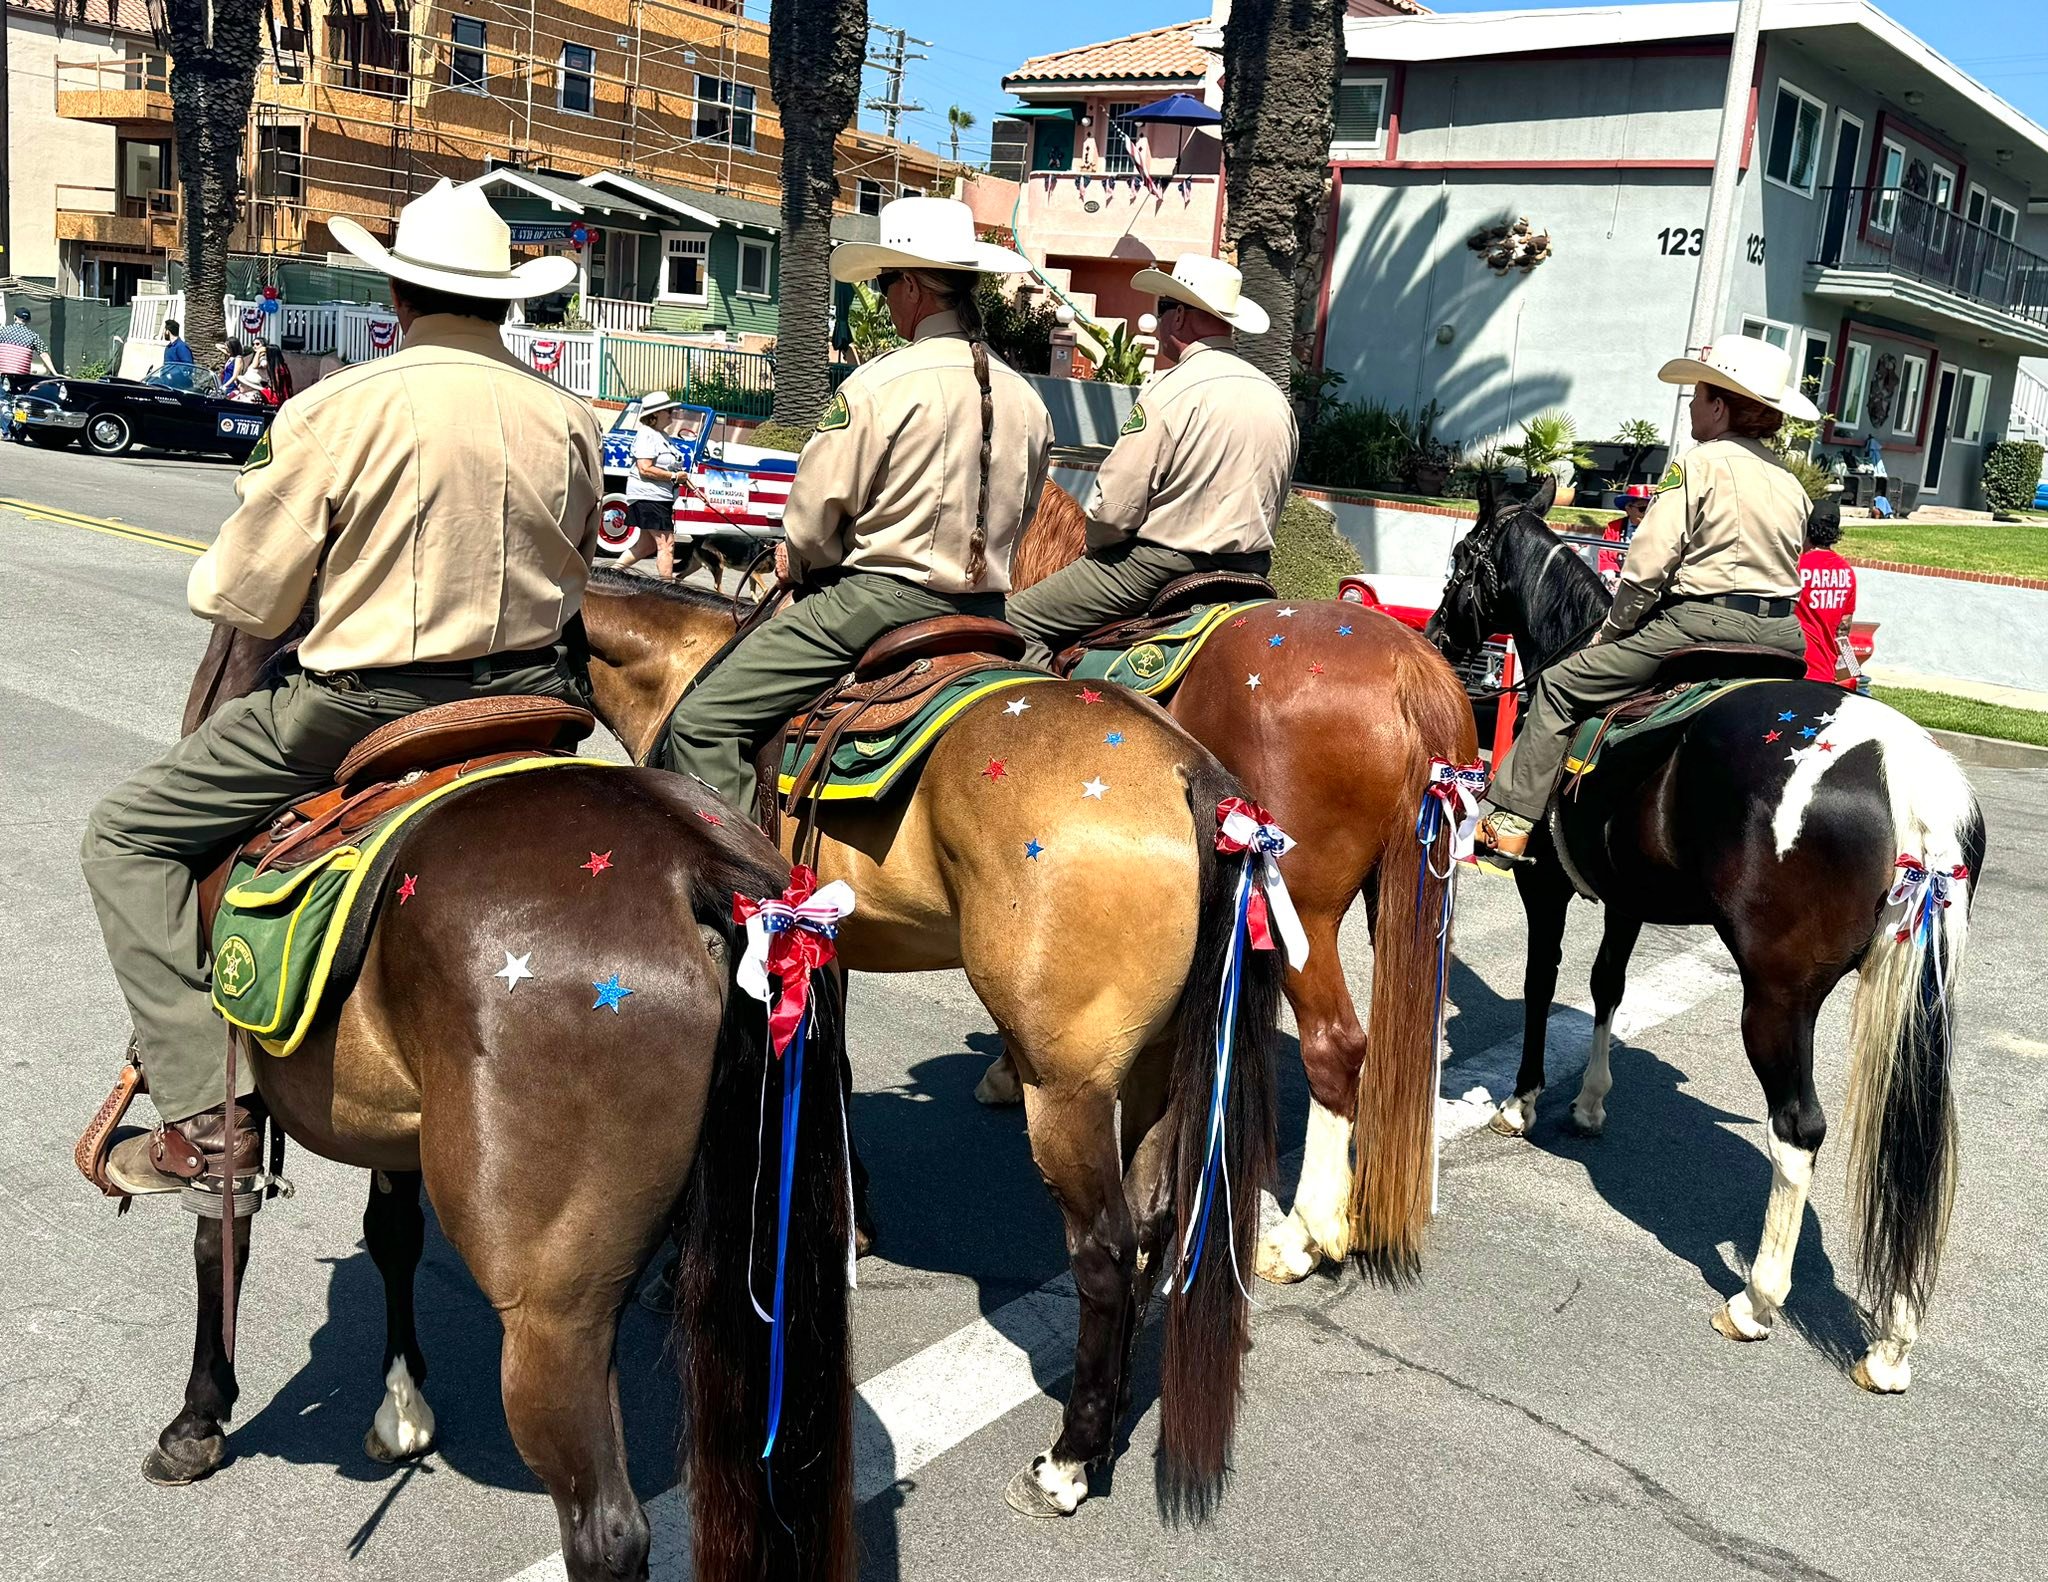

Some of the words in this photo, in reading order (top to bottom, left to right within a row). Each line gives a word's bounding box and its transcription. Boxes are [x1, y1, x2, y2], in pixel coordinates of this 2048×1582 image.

[1657, 227, 1704, 256] 123
[1746, 232, 1766, 266] 123
[236, 422, 250, 435] TRI
[250, 423, 260, 436] TA
[1800, 568, 1852, 588] PARADE
[1808, 589, 1848, 609] STAFF
